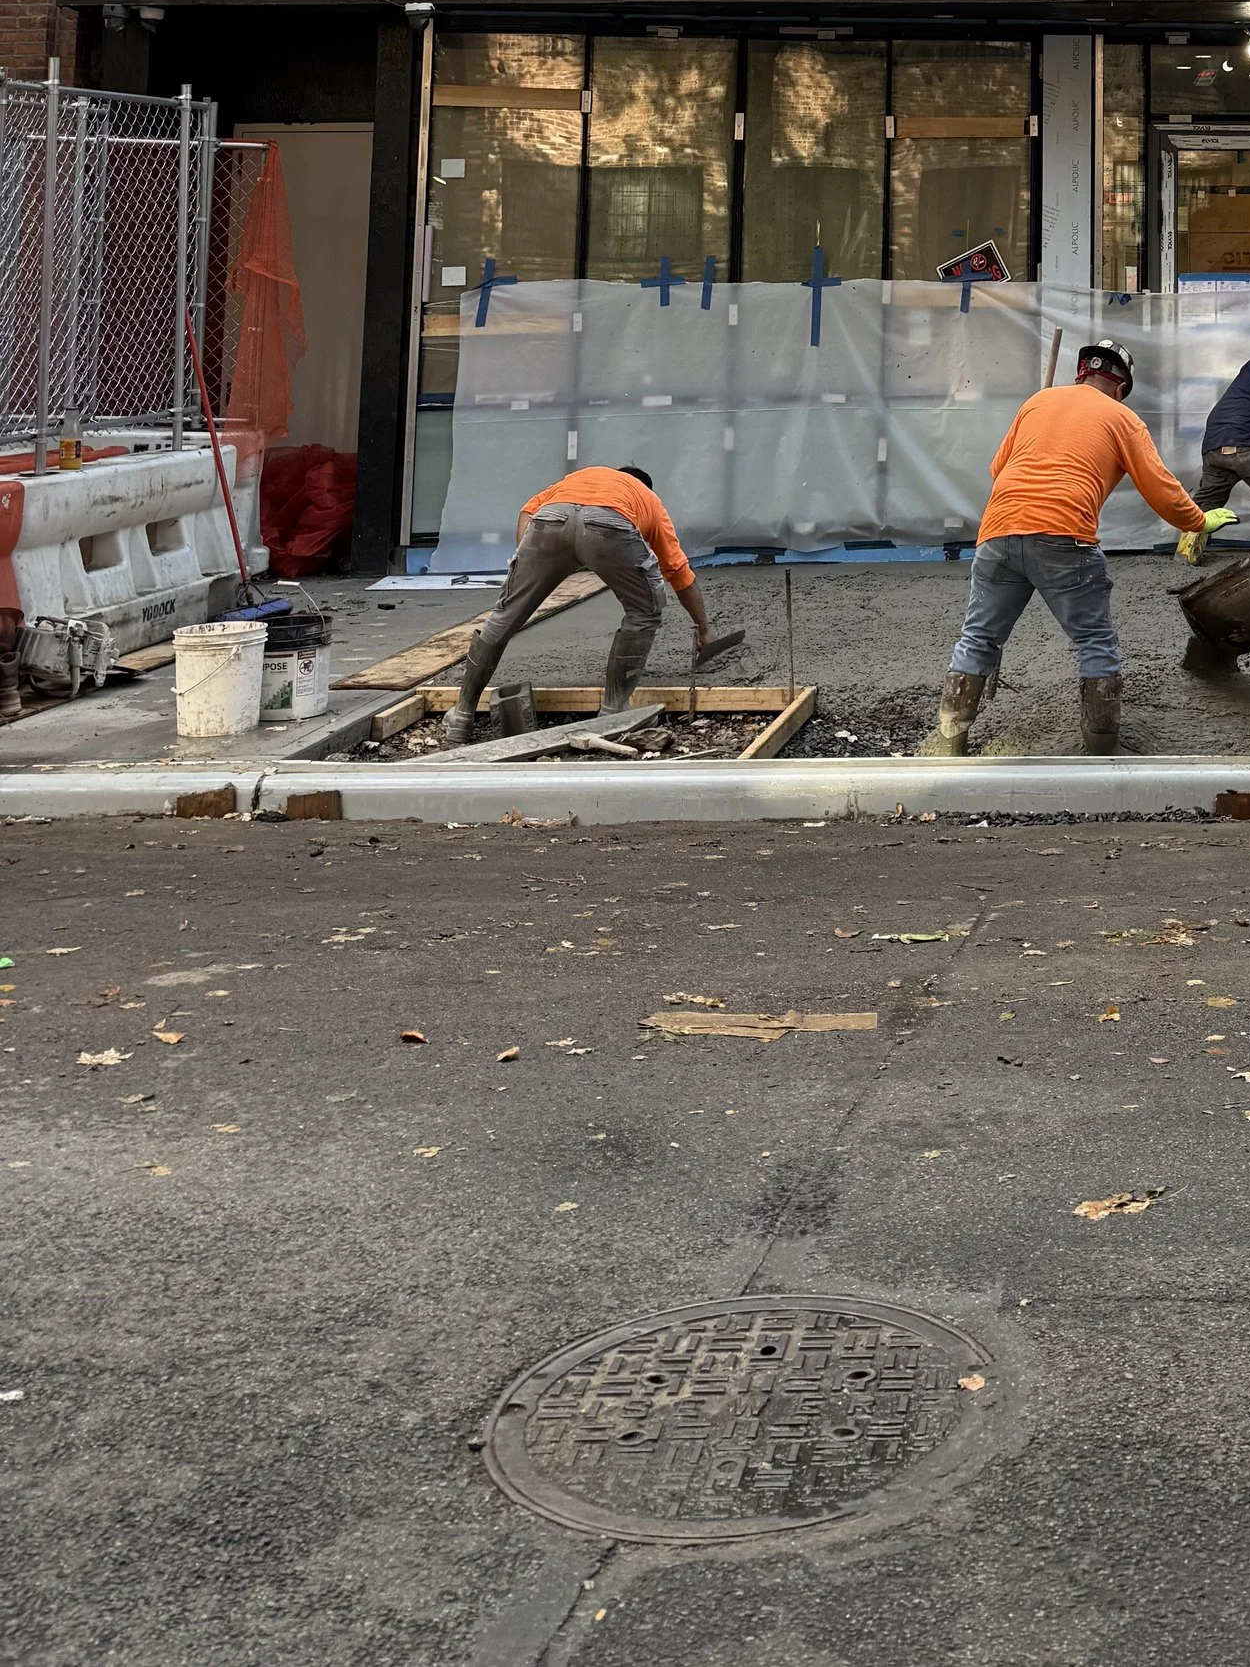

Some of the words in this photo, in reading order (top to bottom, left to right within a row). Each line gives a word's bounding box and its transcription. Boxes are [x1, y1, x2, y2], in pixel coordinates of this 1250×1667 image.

[1072, 99, 1080, 132] ALPOLIC
[1072, 159, 1080, 193] ALPOLIC
[263, 662, 288, 672] POSE
[620, 1394, 876, 1419] SEWER
